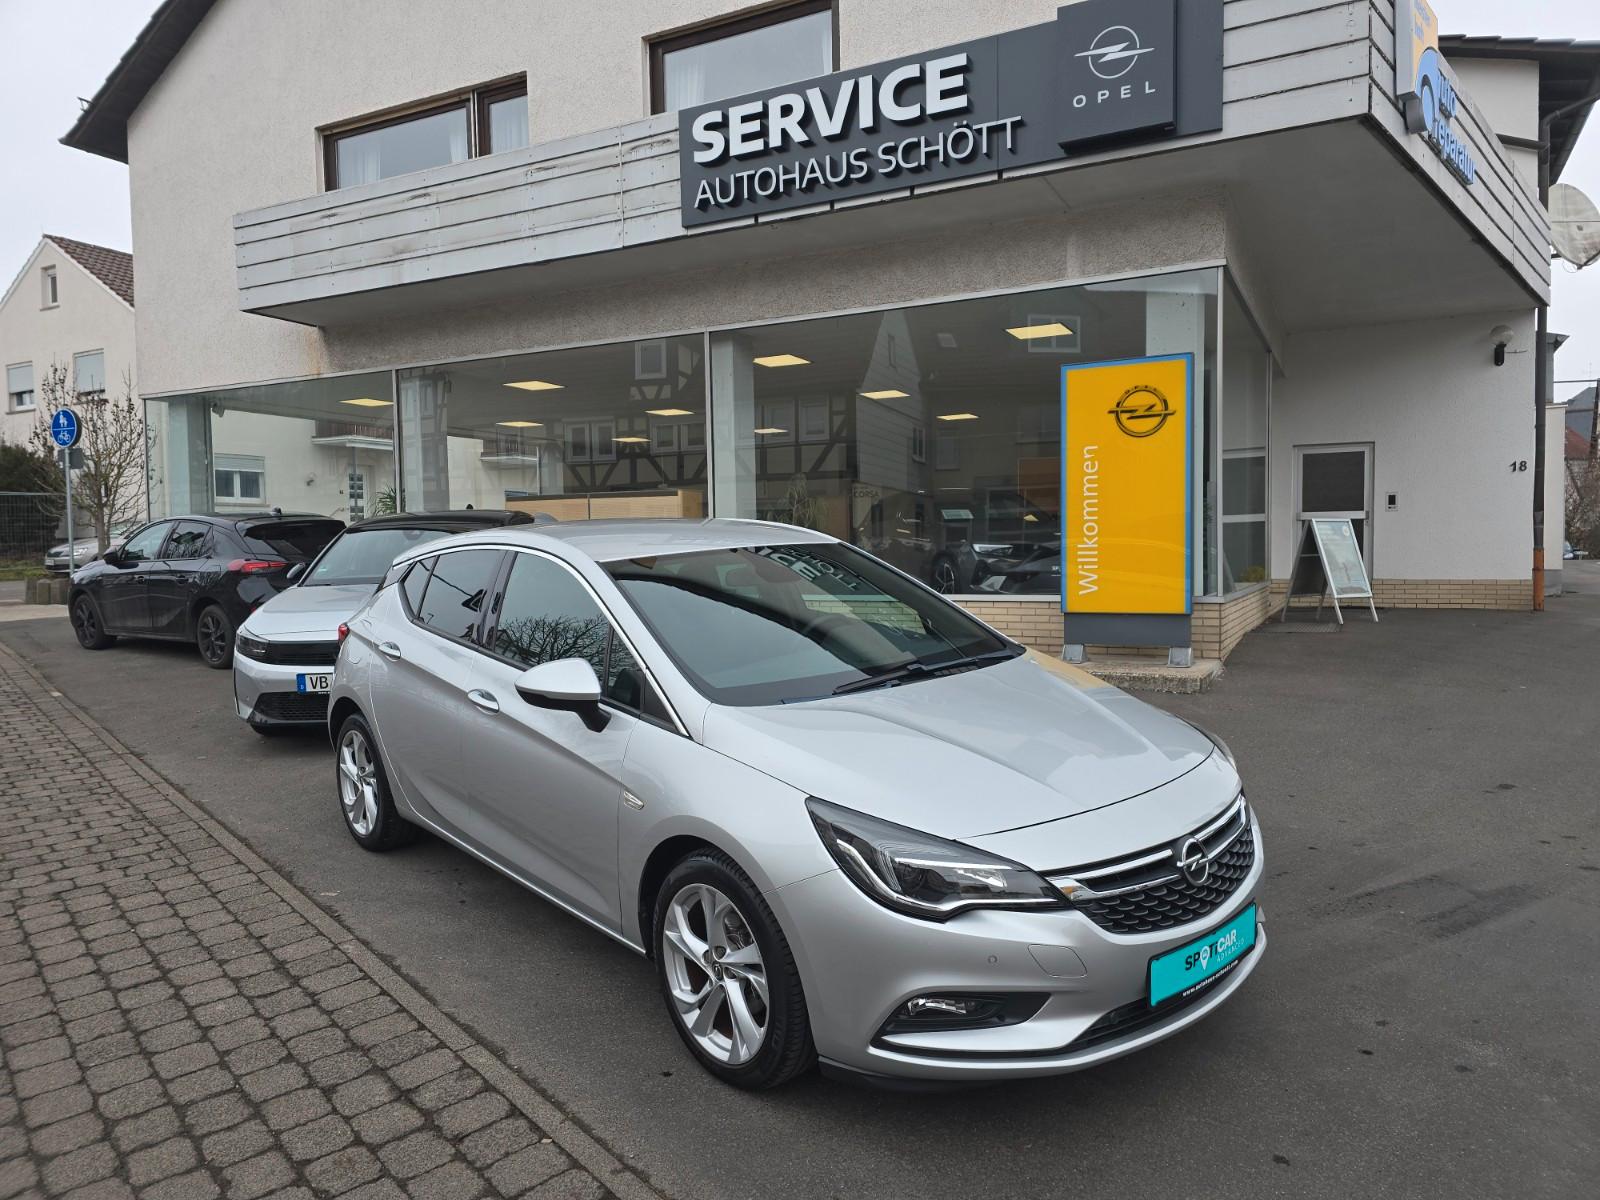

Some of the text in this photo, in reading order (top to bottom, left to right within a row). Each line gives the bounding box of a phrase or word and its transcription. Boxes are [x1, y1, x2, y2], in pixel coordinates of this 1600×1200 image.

[693, 52, 968, 164] SERVICE
[1072, 82, 1156, 108] OPEL
[694, 116, 1022, 208] AUTOHAUS SCHÖTT
[1509, 460, 1527, 472] 18
[1077, 445, 1098, 596] Willkommen
[310, 676, 328, 690] VB
